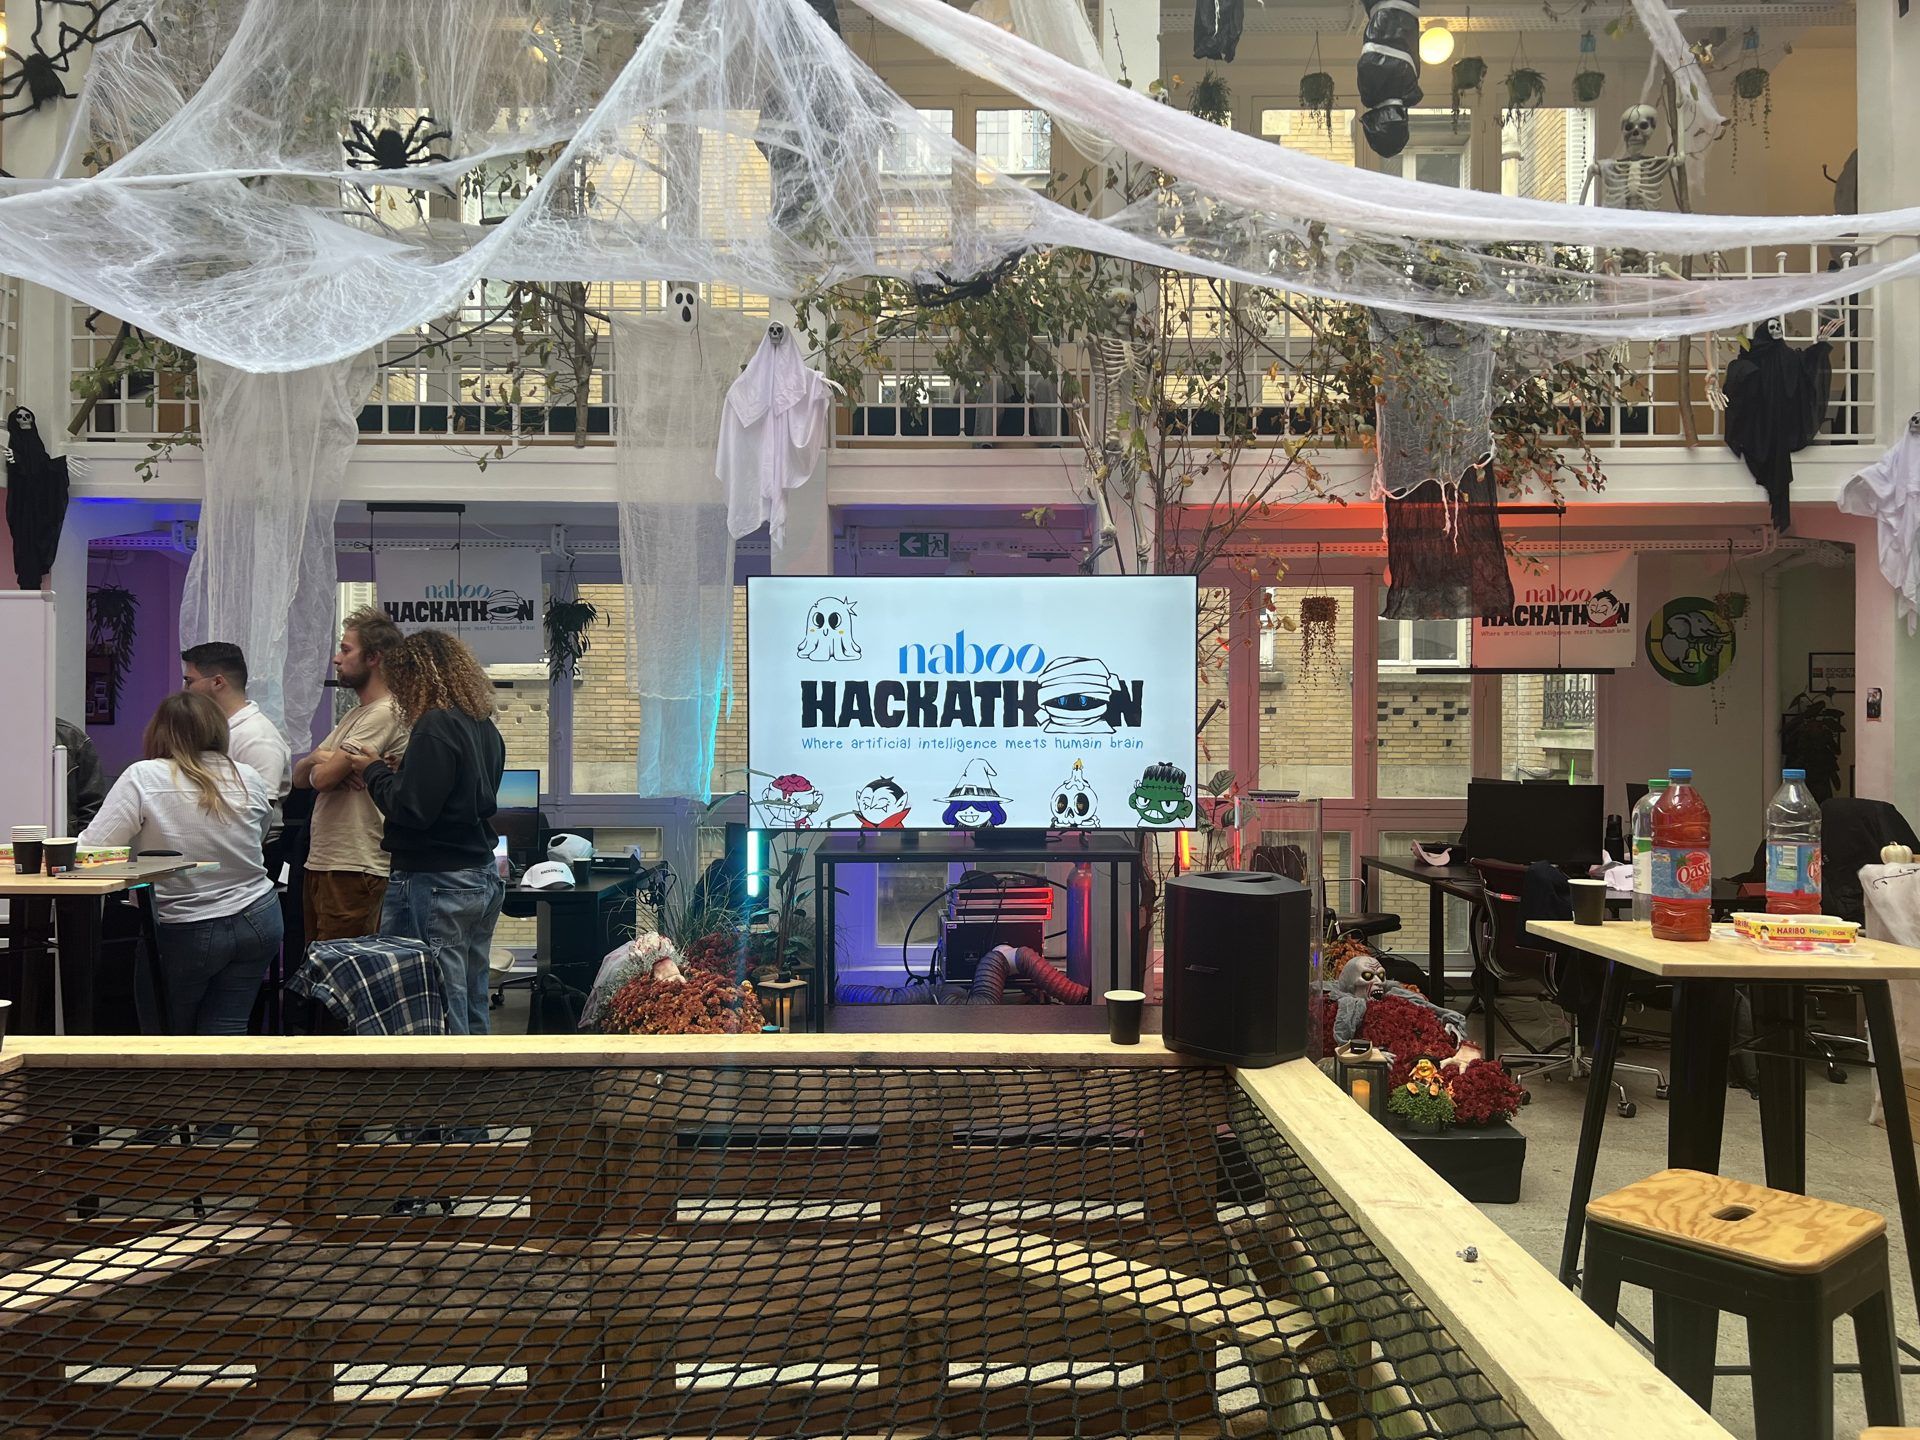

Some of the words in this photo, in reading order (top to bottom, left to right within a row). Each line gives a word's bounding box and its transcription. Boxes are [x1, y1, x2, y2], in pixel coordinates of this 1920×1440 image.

[424, 579, 490, 599] naboo
[1525, 584, 1592, 603] naboo
[899, 630, 1046, 675] naboo
[801, 736, 843, 750] Where
[850, 736, 911, 750] artificial
[918, 736, 997, 753] intelligence
[1005, 736, 1047, 750] meets
[1055, 736, 1102, 750] humain
[1110, 736, 1144, 750] brain
[1776, 927, 1806, 935] HARIBO
[1809, 928, 1831, 937] Happy
